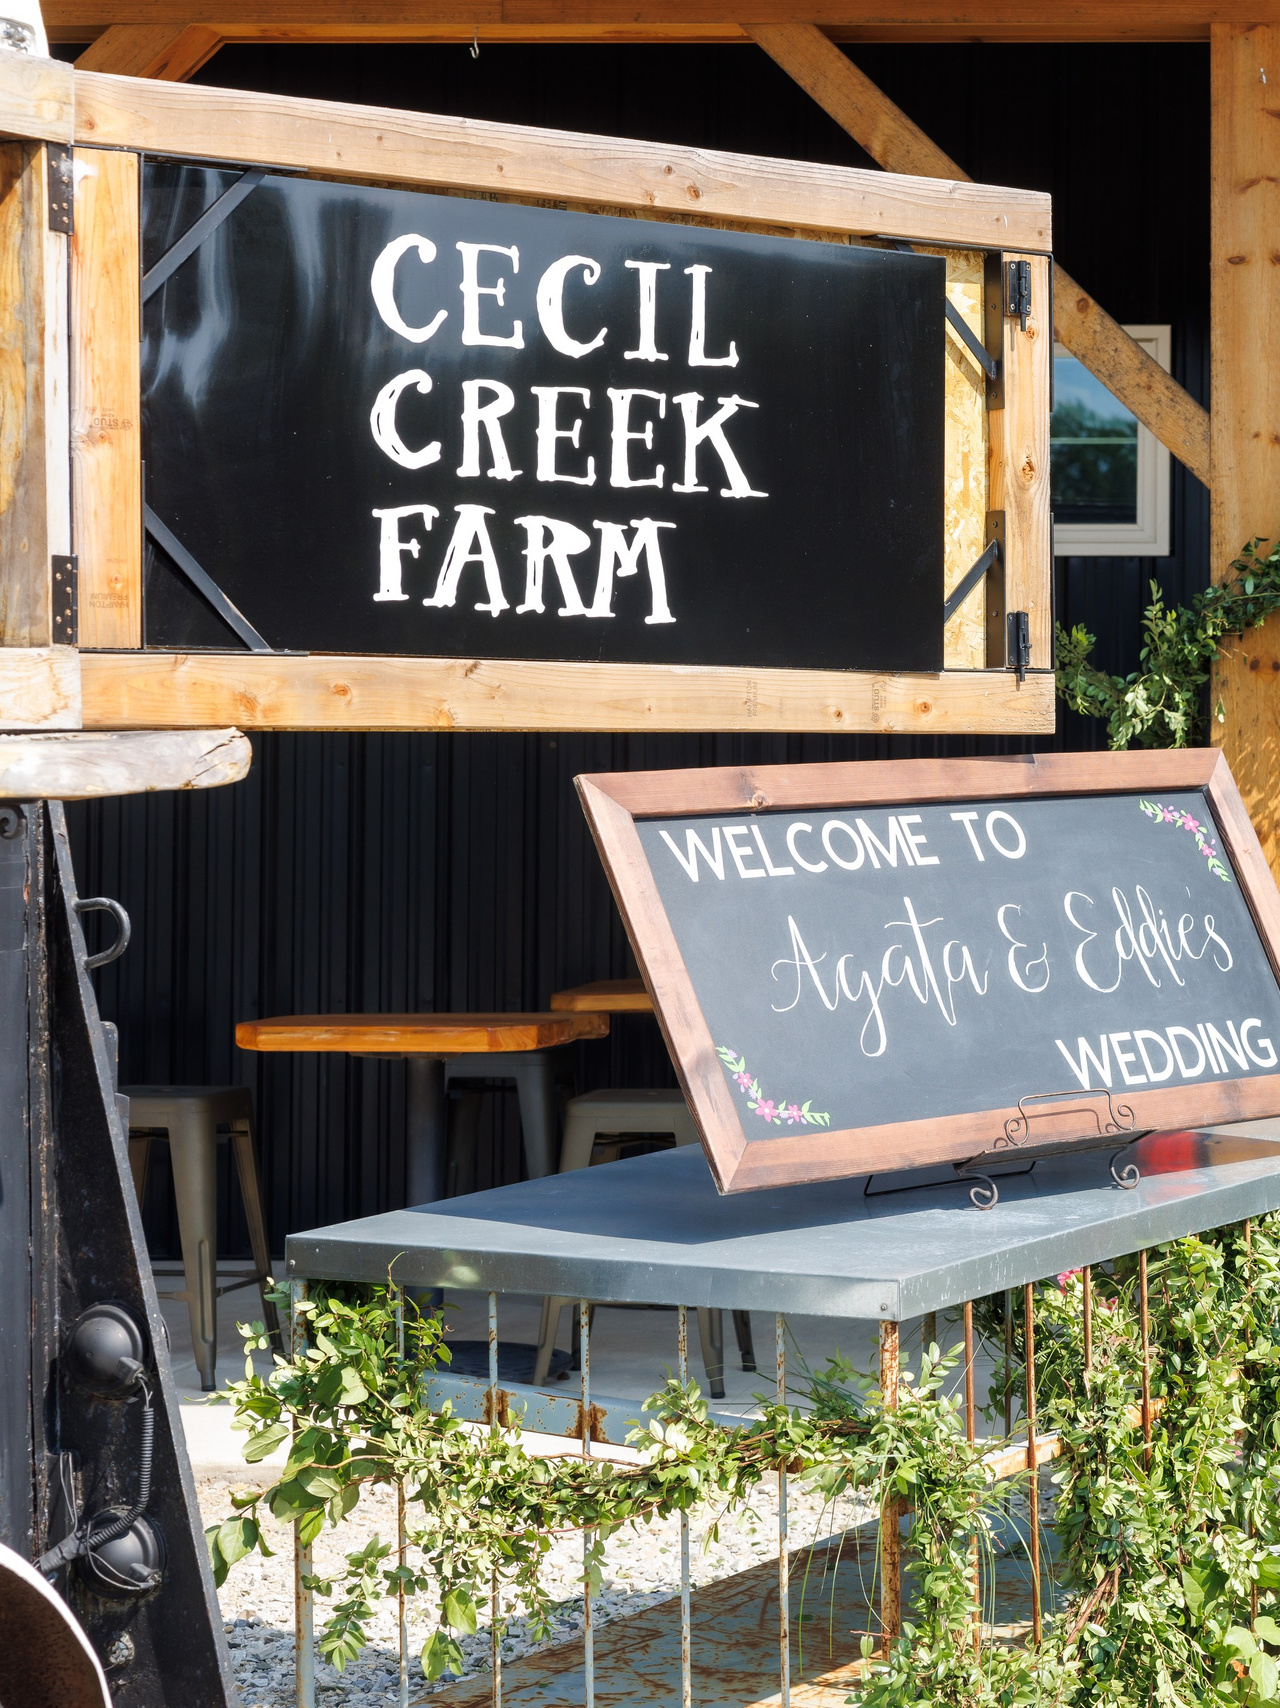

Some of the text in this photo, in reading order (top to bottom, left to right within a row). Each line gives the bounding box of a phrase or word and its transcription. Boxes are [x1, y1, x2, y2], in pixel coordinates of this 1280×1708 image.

[370, 233, 739, 367] CECIL
[94, 418, 119, 426] STUD
[370, 369, 769, 498] CREEK
[89, 600, 129, 608] HAMPTON
[372, 504, 676, 624] FARM
[659, 810, 1027, 883] WELCOME TO
[771, 885, 1234, 1057] Agata & Eddie's
[1055, 1018, 1277, 1090] WEDDING
